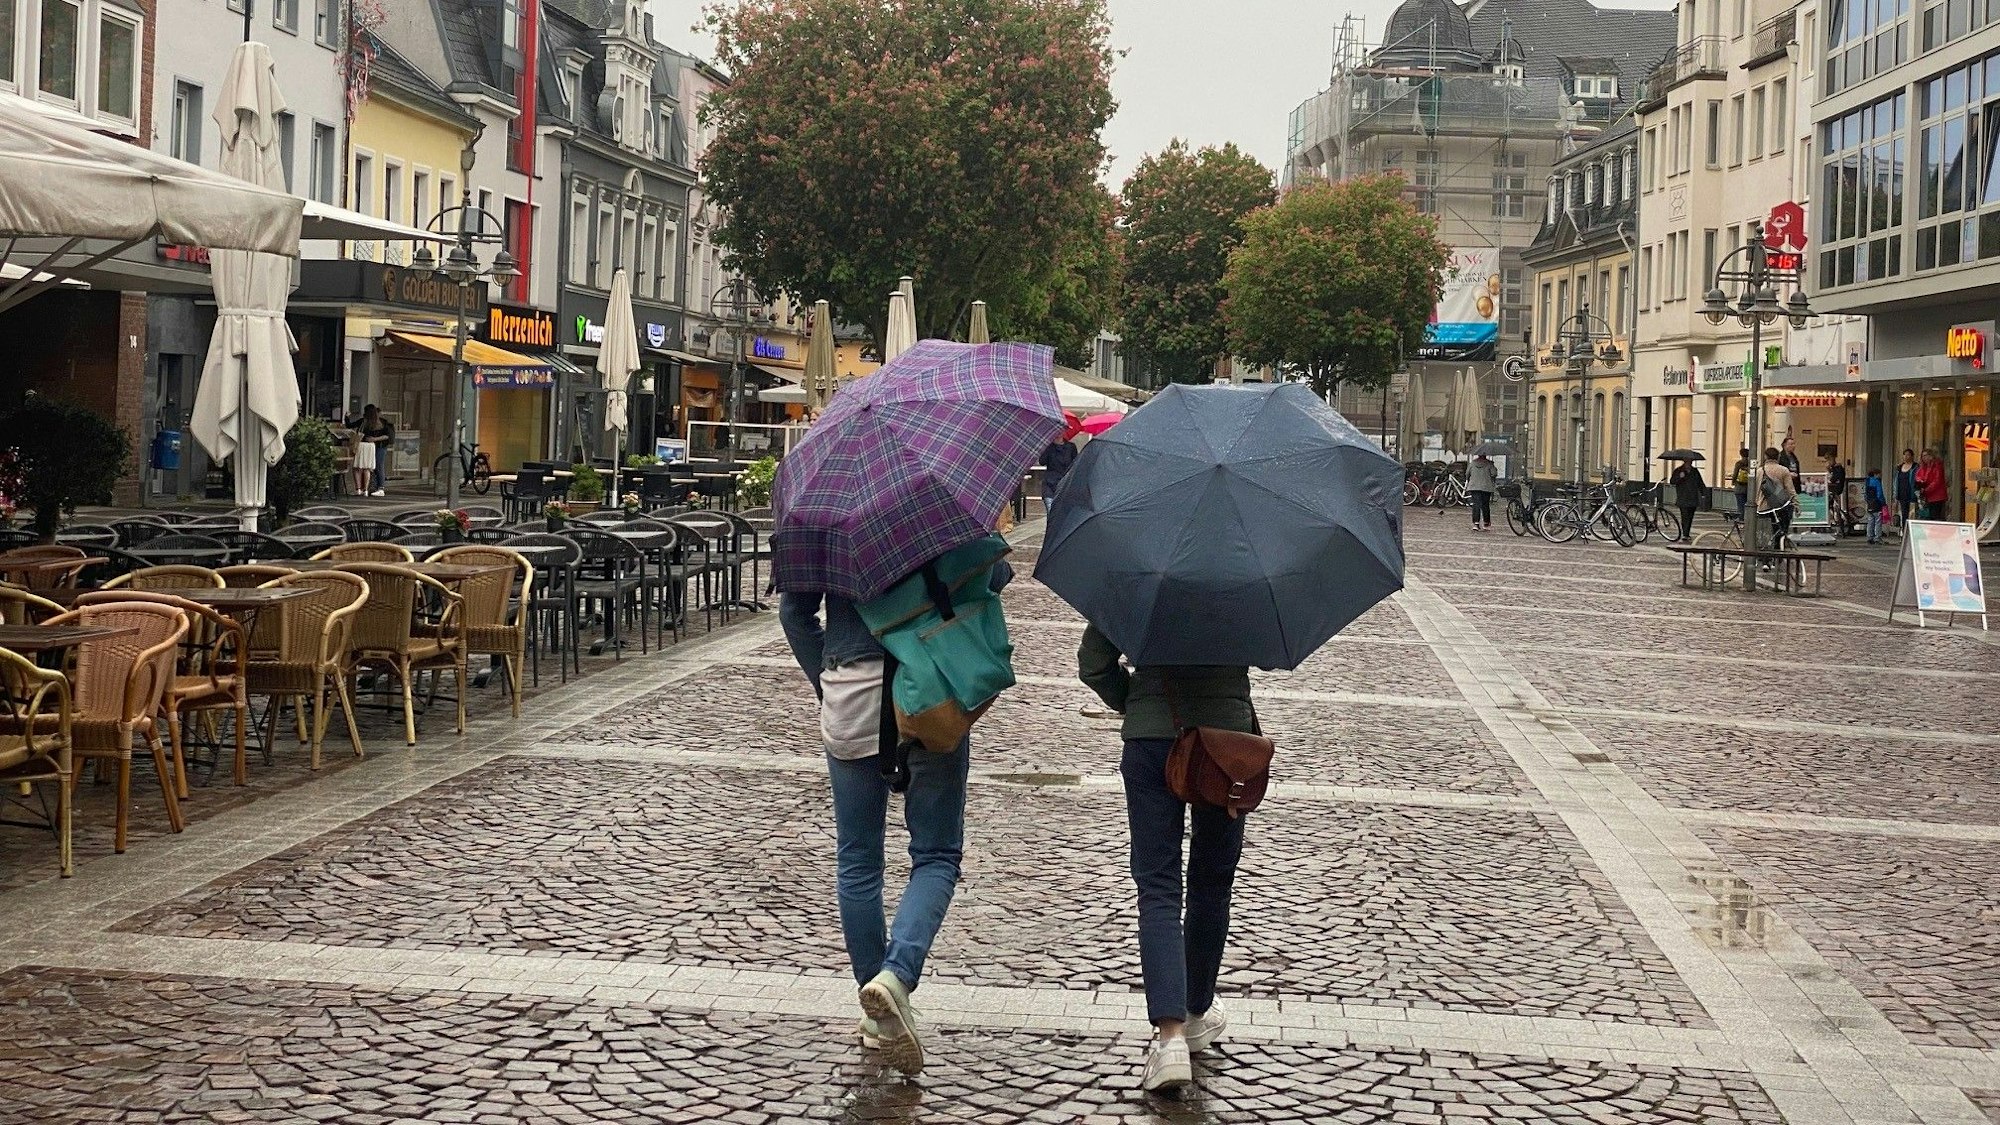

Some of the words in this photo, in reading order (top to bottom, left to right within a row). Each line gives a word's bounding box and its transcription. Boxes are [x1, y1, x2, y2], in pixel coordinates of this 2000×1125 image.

[402, 275, 441, 305] GOLDEN
[441, 282, 476, 310] BURER
[490, 307, 553, 347] Merzenich
[1946, 328, 1978, 358] Netto
[1774, 398, 1837, 408] APOTHEKE
